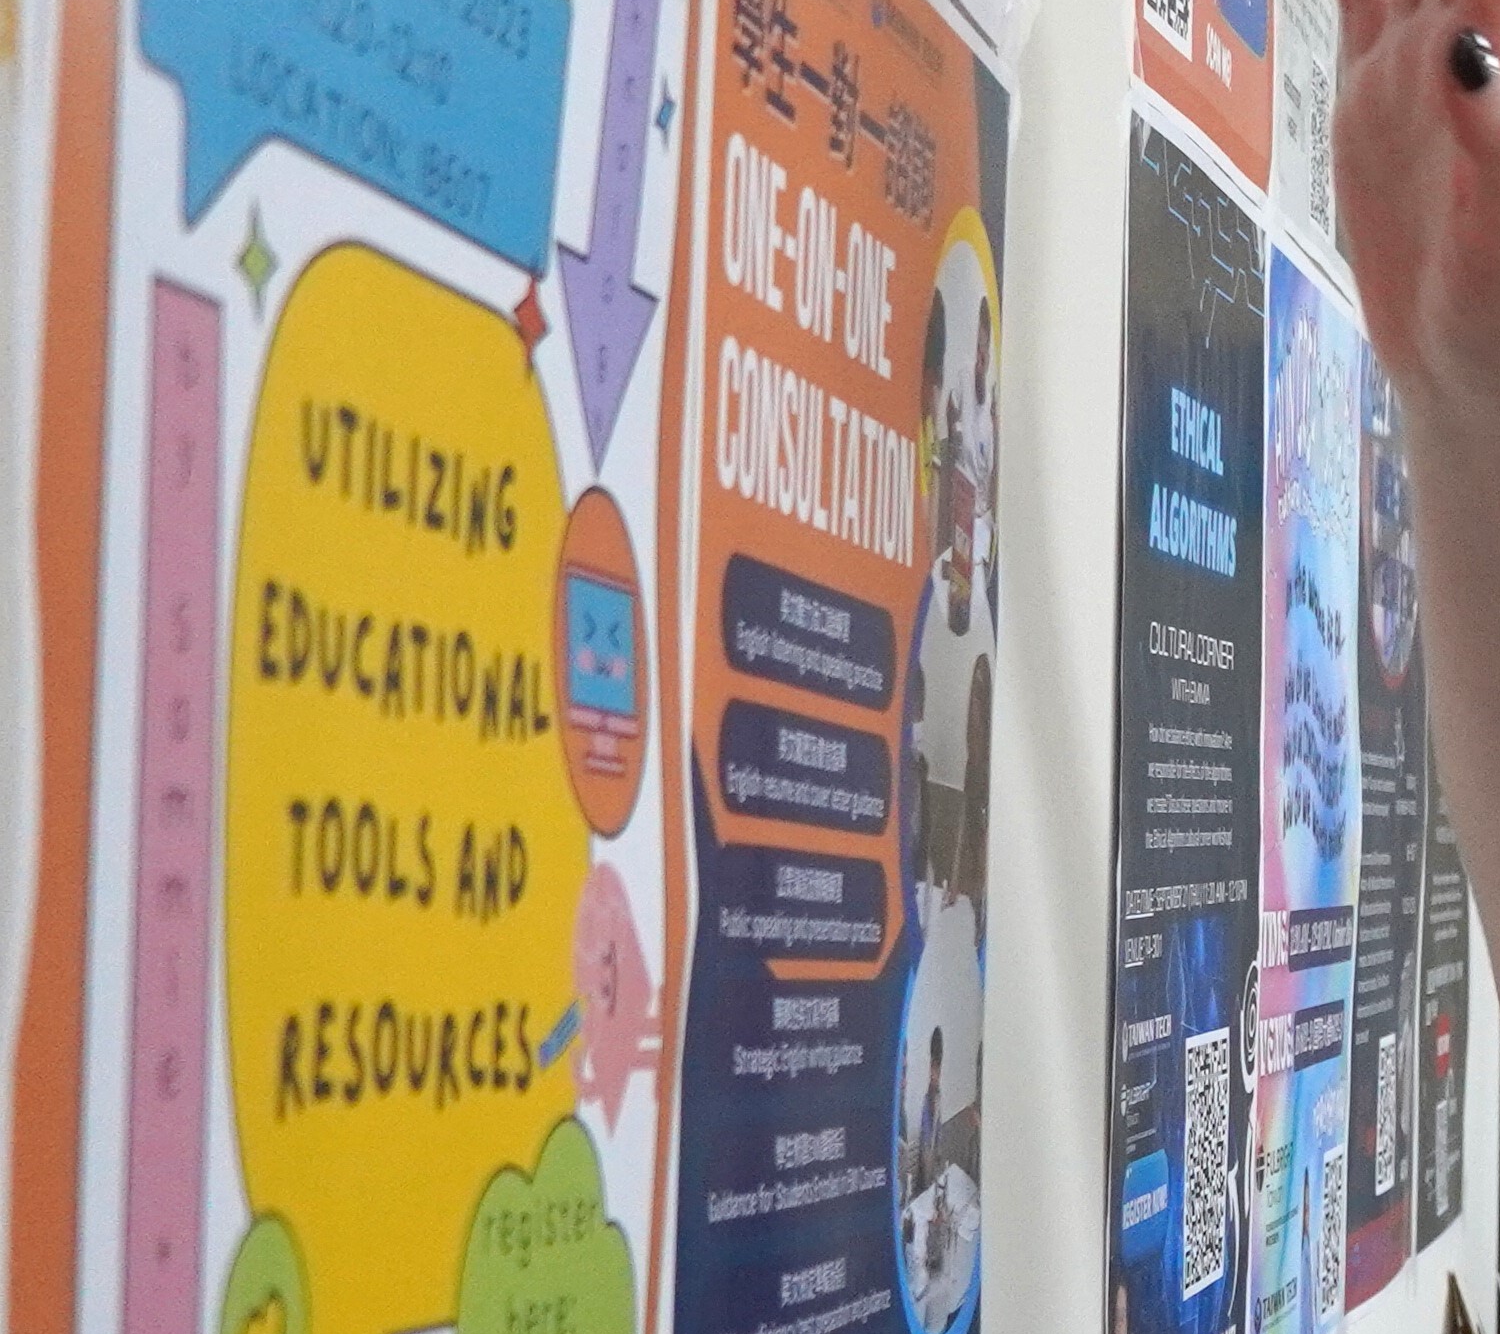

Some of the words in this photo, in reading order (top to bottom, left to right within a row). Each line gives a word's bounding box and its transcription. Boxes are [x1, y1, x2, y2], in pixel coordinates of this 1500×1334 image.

[723, 133, 893, 380] ONE-ON-ONE
[301, 399, 518, 557] UTILIZING
[716, 336, 915, 568] CONSULTATION
[1170, 384, 1224, 479] ETHICAL
[1149, 476, 1236, 584] ALGORITHMS
[259, 578, 550, 742] EDUCATIONAL
[1149, 615, 1196, 668] CULTURAL
[1196, 629, 1234, 675] CORNER
[288, 799, 436, 907] TOOLS
[455, 823, 527, 925] AND
[276, 1003, 534, 1122] RESOURCES
[1127, 1016, 1154, 1050] TAIWAN
[1154, 1011, 1171, 1041] TECH
[482, 1194, 599, 1272] register
[1122, 1189, 1152, 1232] REGISTER
